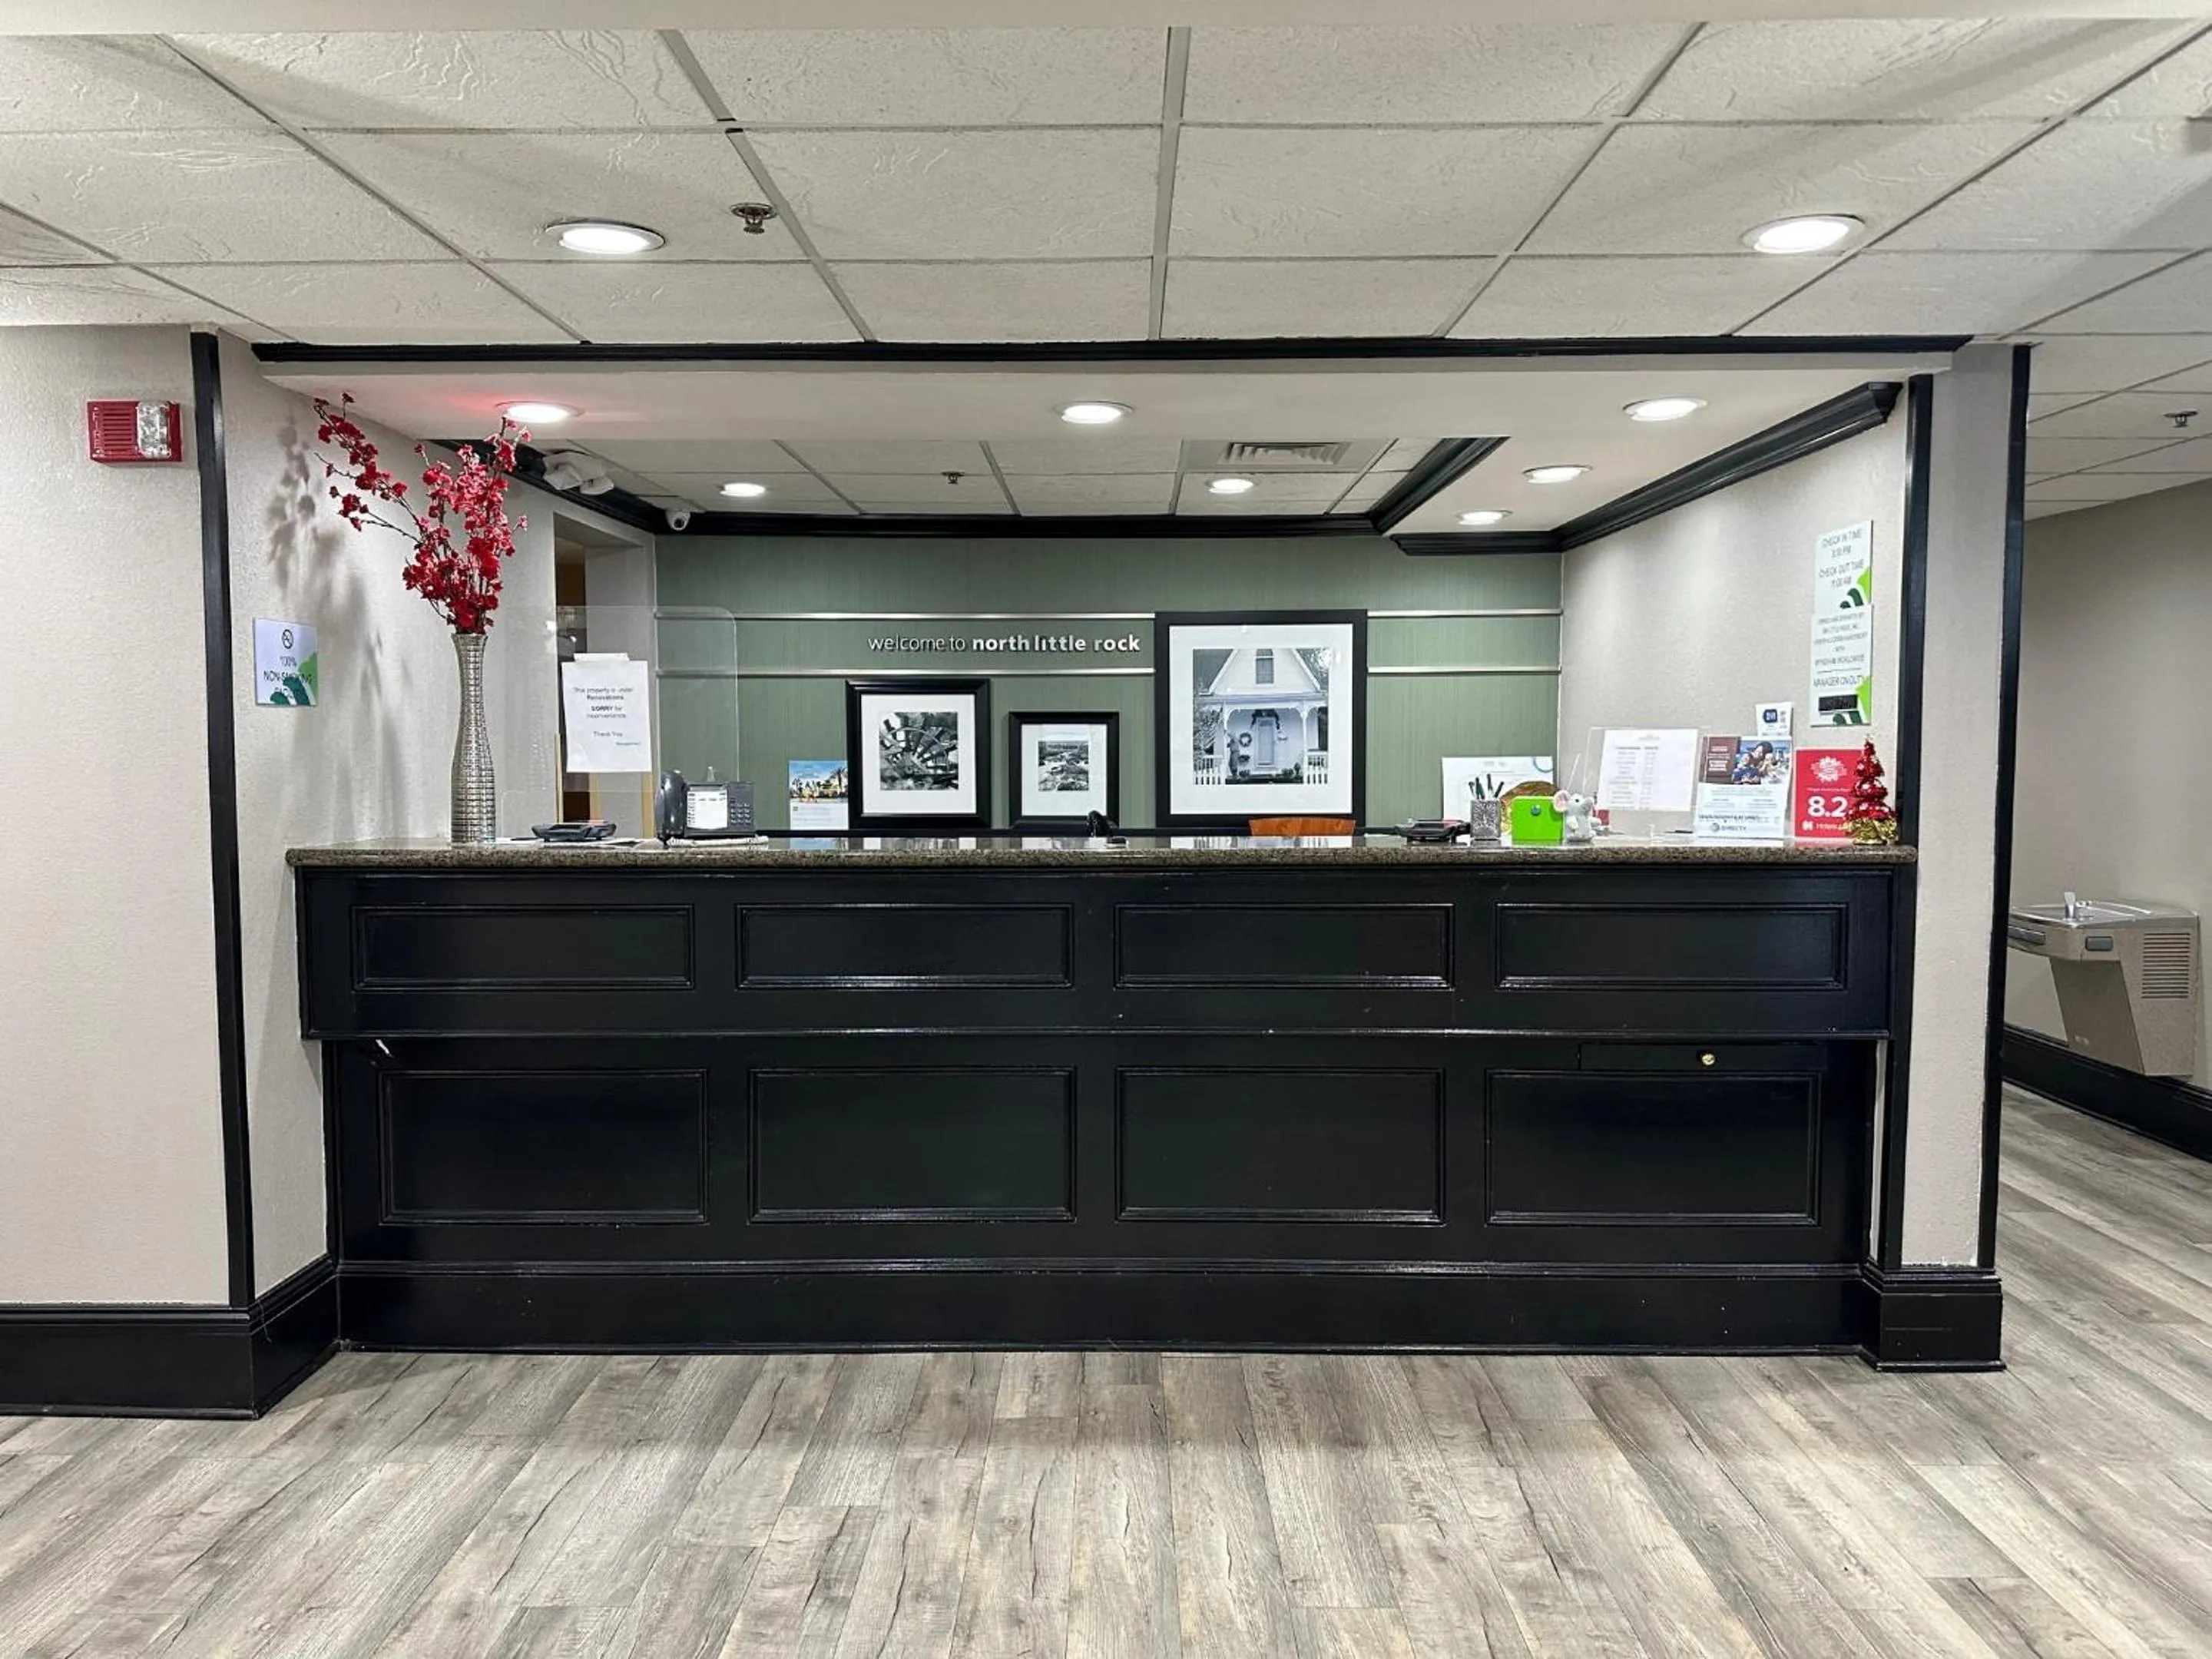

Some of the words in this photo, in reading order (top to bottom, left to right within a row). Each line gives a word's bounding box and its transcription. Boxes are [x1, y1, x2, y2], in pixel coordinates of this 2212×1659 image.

[868, 634, 945, 651] welcome
[949, 636, 965, 651] to
[972, 634, 1030, 651] north
[1035, 634, 1087, 651] little
[1094, 634, 1141, 651] rock
[1807, 795, 1849, 818] 8.2
